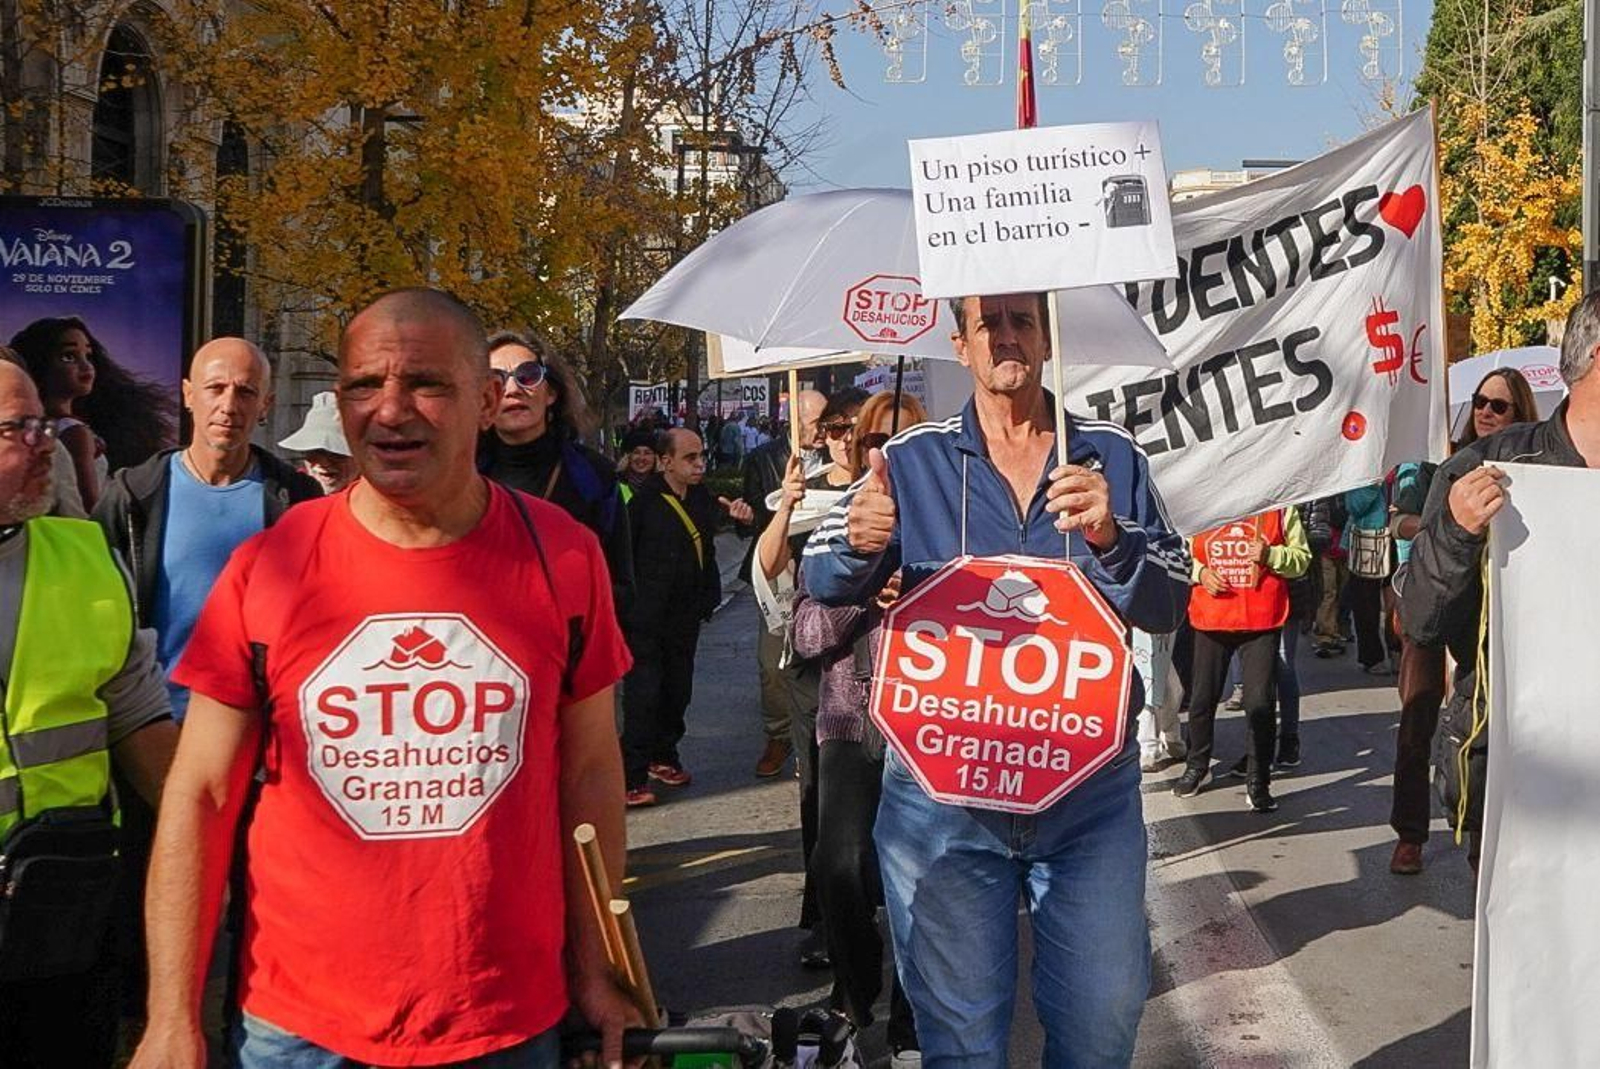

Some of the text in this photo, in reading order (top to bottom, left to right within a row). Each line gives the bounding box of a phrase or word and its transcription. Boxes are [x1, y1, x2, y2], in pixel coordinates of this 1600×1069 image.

[922, 160, 958, 180] Un
[968, 154, 1018, 183] piso
[1027, 145, 1126, 172] turístico
[924, 183, 1072, 214] Una familia
[927, 229, 956, 248] en
[965, 221, 987, 244] el
[995, 216, 1069, 241] barrio
[0, 237, 134, 269] VAIANA 2
[12, 274, 115, 285] 29 DE NOVIEMBRE
[25, 284, 102, 293] SOLO EN CINES
[855, 289, 929, 312] STOP
[852, 310, 927, 326] DESAHUCIOS
[1211, 541, 1250, 556] STO
[898, 620, 1113, 700] STOP
[317, 681, 516, 739] STOP
[891, 684, 1103, 738] Desahucios
[321, 741, 510, 768] Desahucios
[916, 724, 1071, 772] Granada
[343, 773, 485, 801] Granada
[957, 764, 1024, 795] 15 M
[381, 804, 443, 827] 15 M
